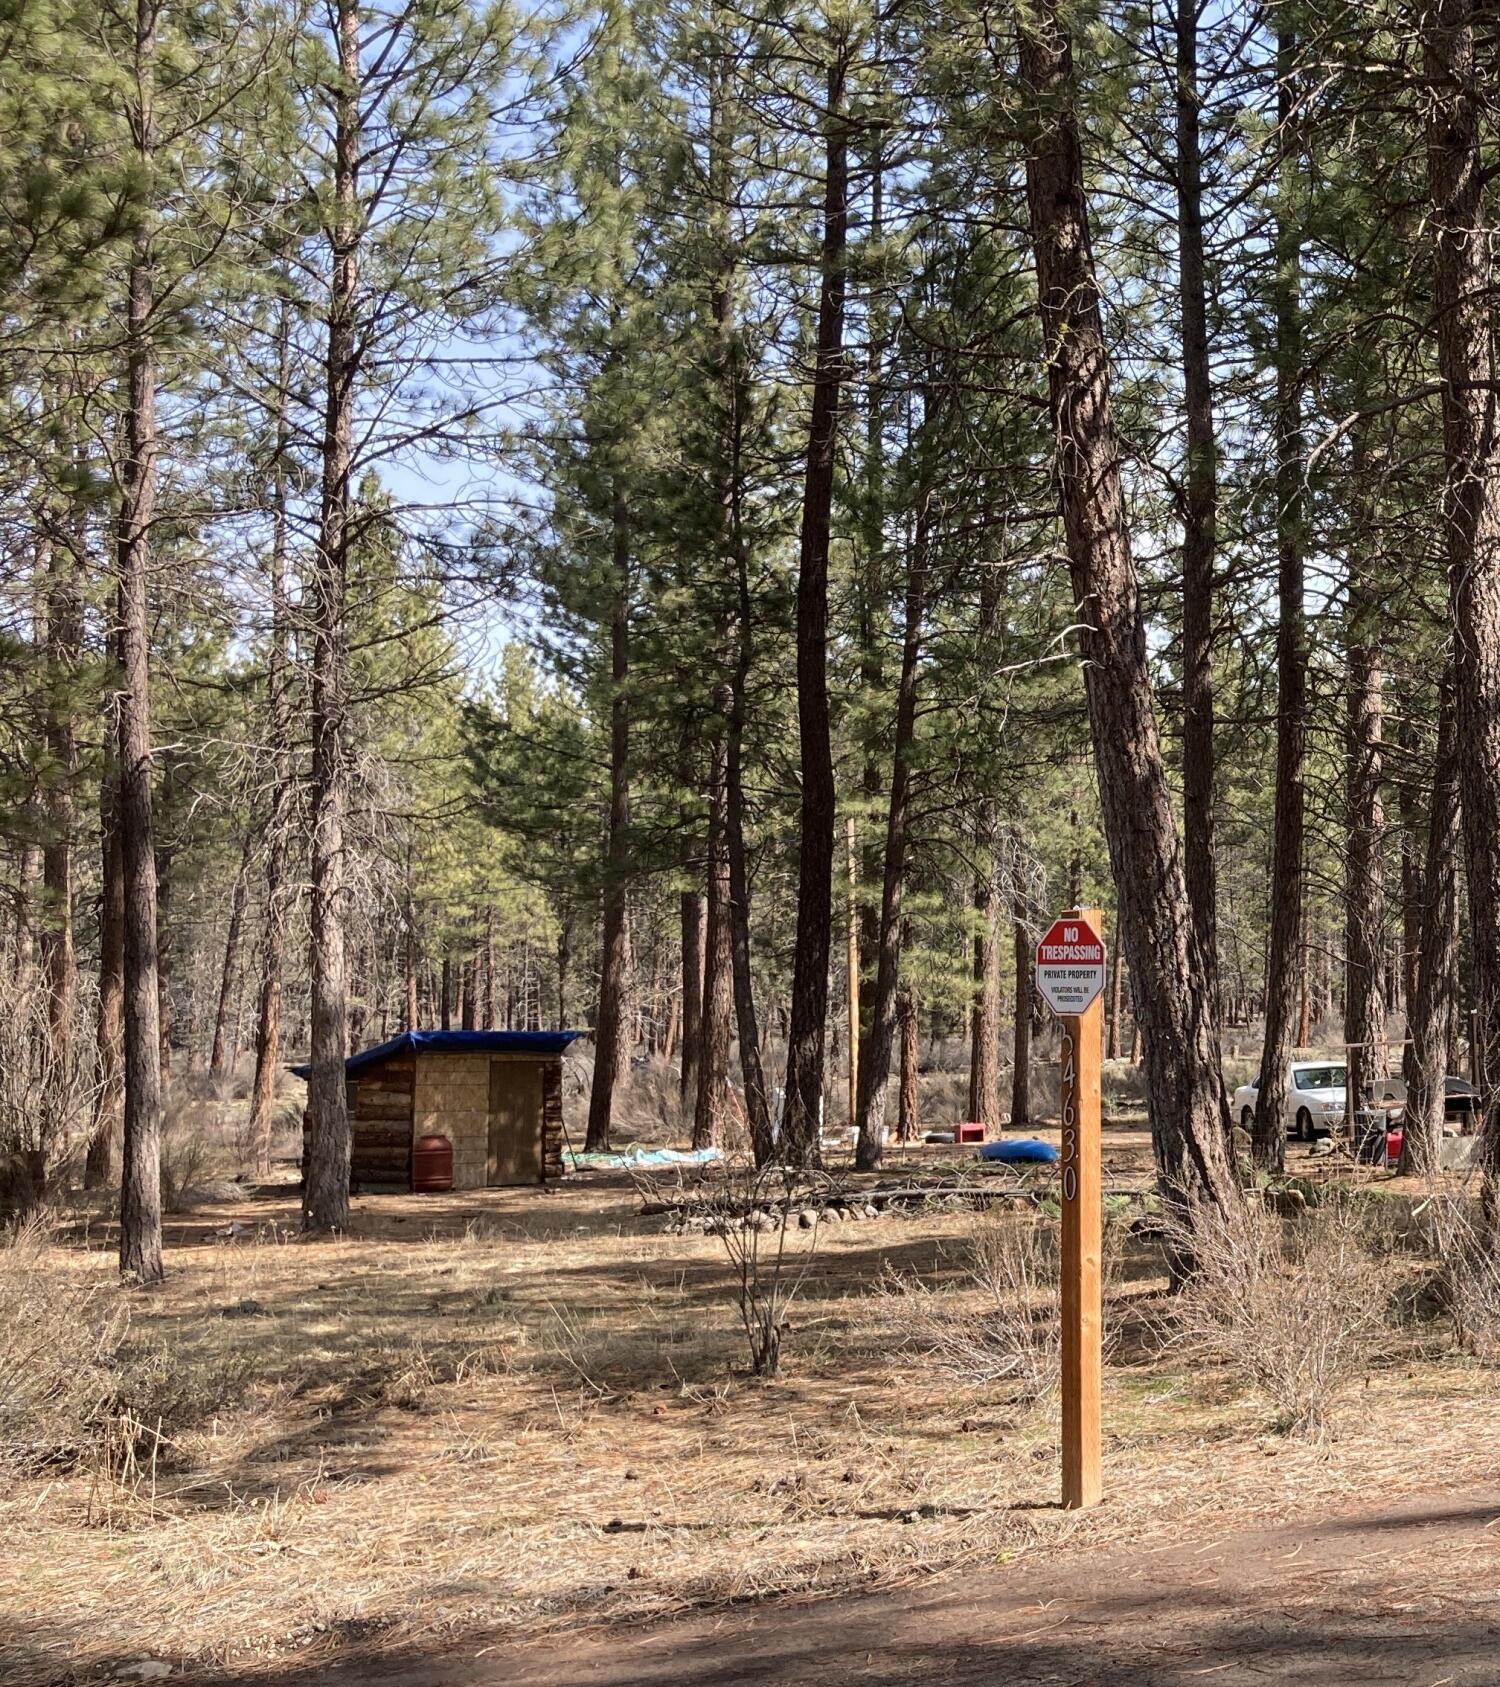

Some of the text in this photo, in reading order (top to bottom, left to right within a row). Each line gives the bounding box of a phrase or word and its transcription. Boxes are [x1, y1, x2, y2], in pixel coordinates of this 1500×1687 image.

[1063, 927, 1079, 943] NO
[1041, 945, 1101, 961] TRESPASSING
[1044, 970, 1097, 979] PRIVATE PROPERTY
